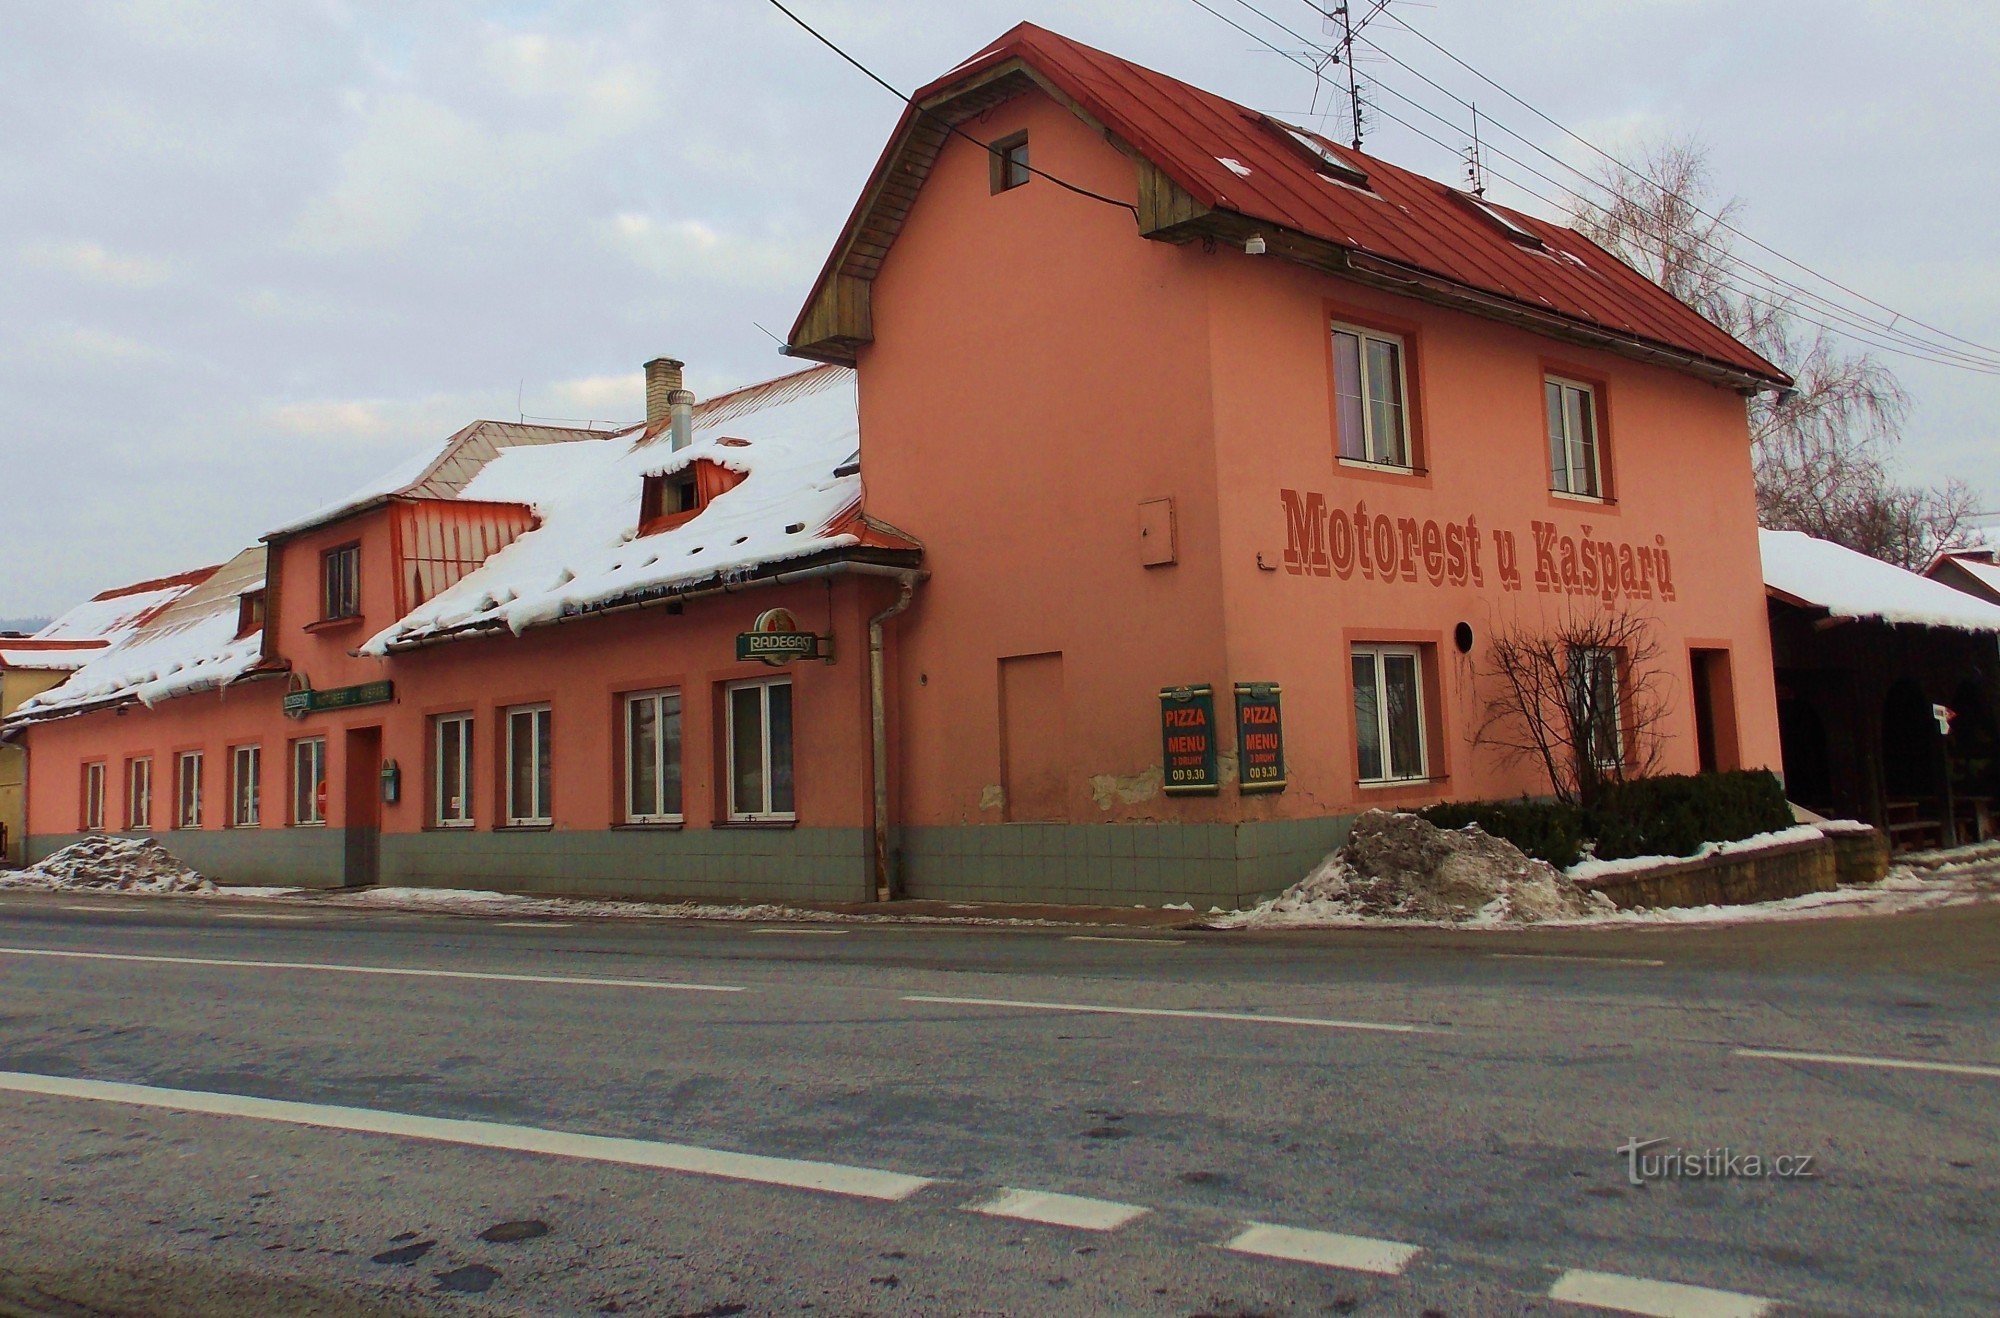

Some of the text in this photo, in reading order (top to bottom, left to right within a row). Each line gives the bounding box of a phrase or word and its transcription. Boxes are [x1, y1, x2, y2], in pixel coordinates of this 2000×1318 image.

[1281, 489, 1676, 610] Motorest u Kašparů
[750, 636, 812, 652] RADEGAST
[1166, 708, 1206, 727] PIZZA
[1243, 706, 1277, 724] PIZZA
[1168, 736, 1206, 752] MENU
[1246, 733, 1278, 750] MENU
[1172, 769, 1205, 780] OD 9.30
[1250, 766, 1277, 778] OD 9.30
